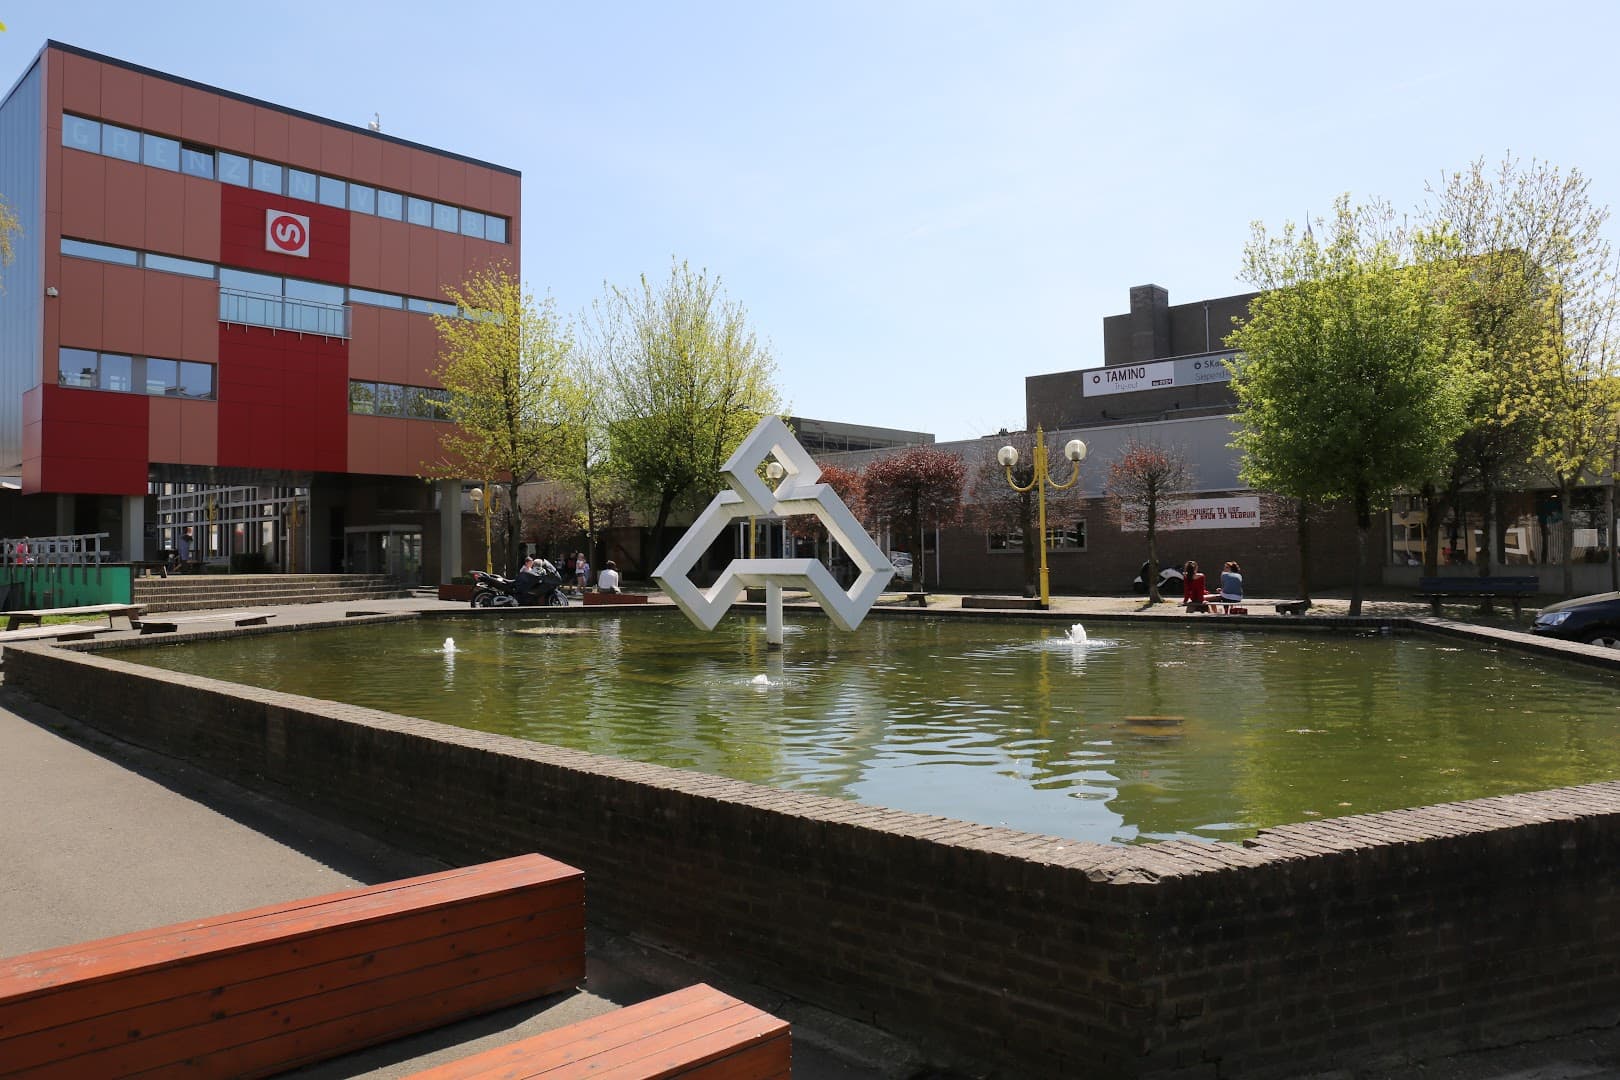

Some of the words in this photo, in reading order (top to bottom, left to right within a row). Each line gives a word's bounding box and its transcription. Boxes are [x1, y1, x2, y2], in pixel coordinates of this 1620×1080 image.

[73, 121, 310, 197] GRENZEN
[1105, 367, 1145, 383] TAMINO
[1231, 511, 1256, 519] GEBRUIK
